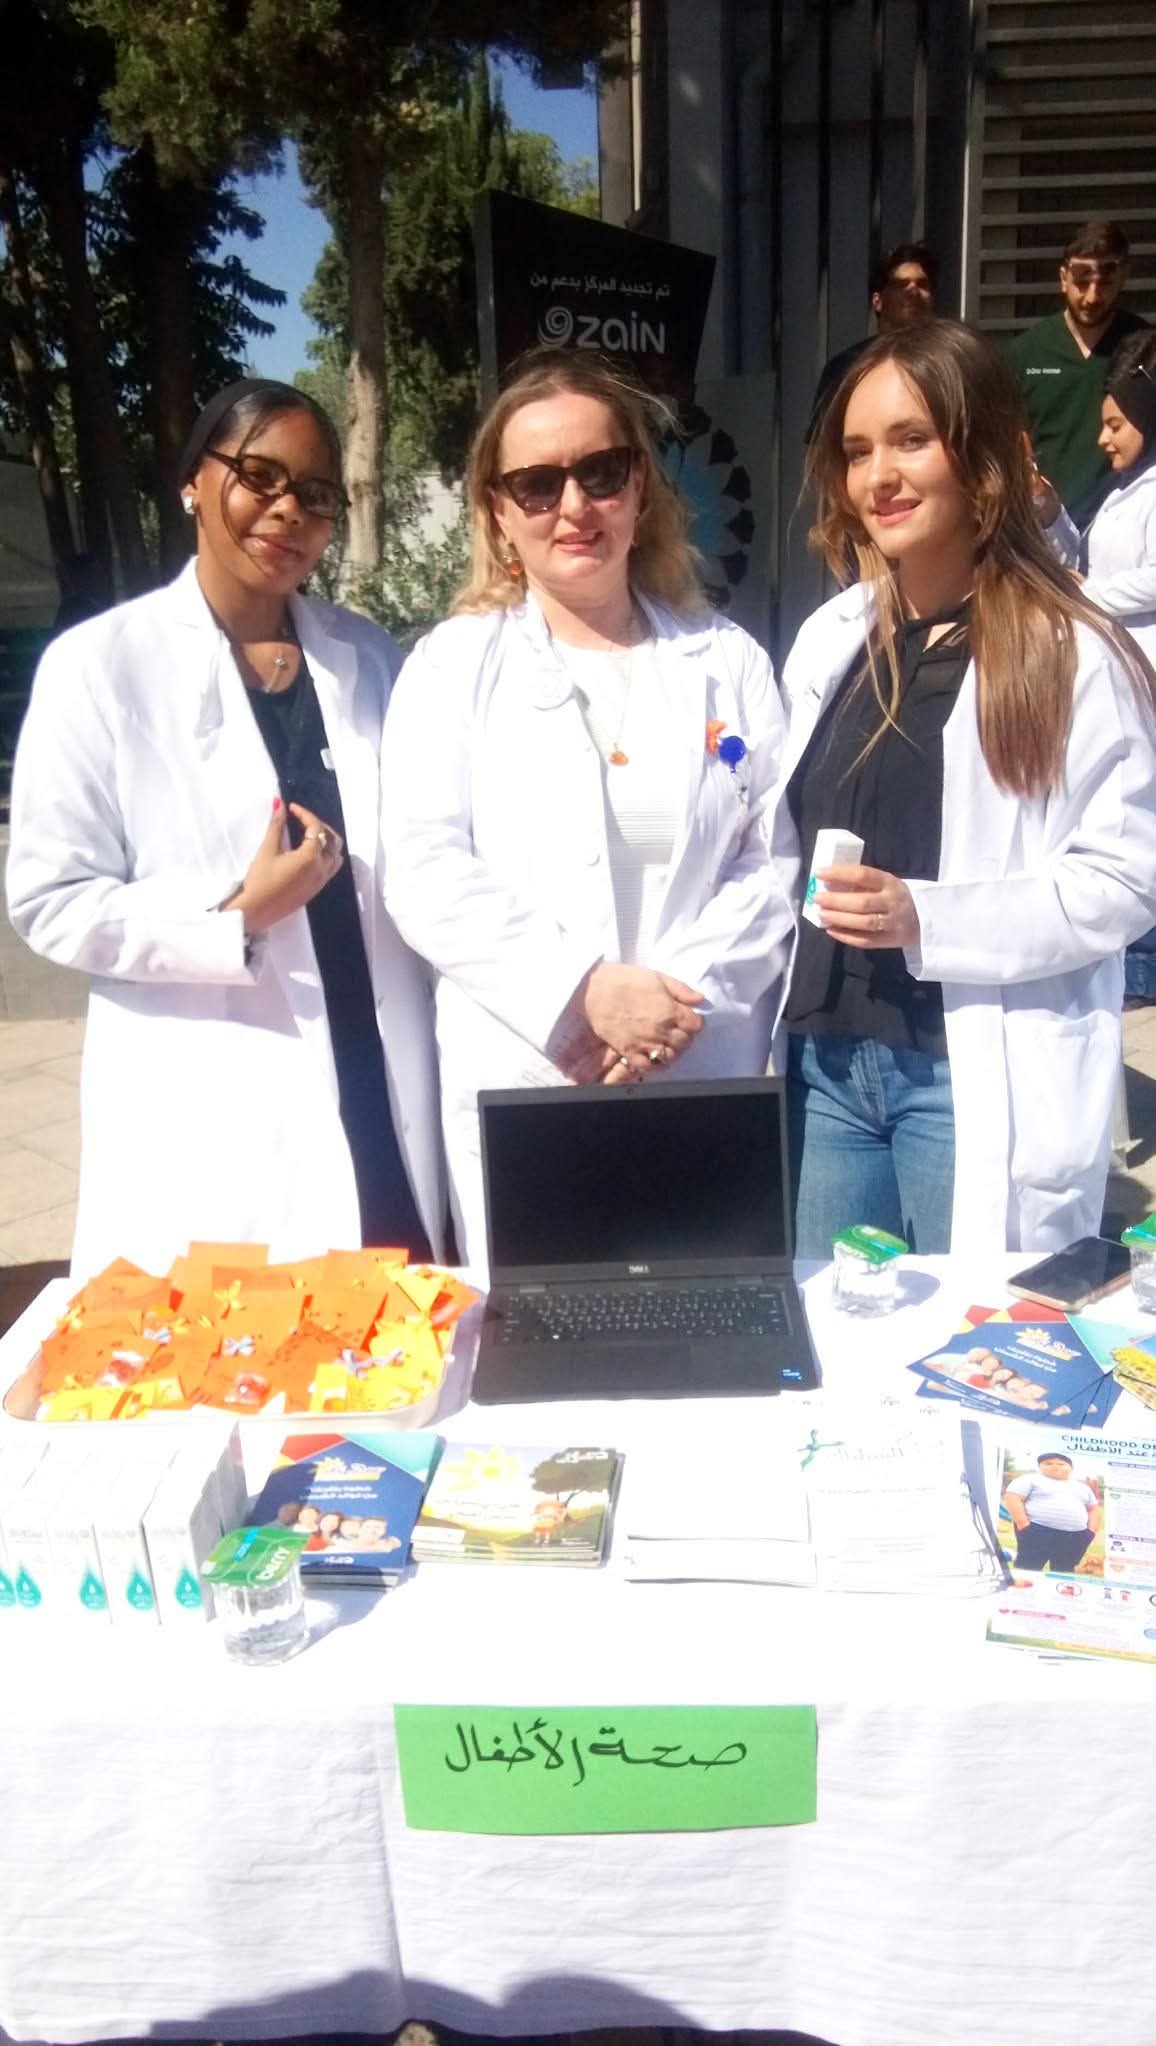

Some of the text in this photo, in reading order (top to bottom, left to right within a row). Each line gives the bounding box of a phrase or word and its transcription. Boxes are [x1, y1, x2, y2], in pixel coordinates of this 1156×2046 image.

[584, 273, 617, 295] المركز
[656, 284, 671, 301] تم
[1061, 1434, 1138, 1449] CHILDHOOD
[445, 1717, 748, 1787] صحة الأطفال
